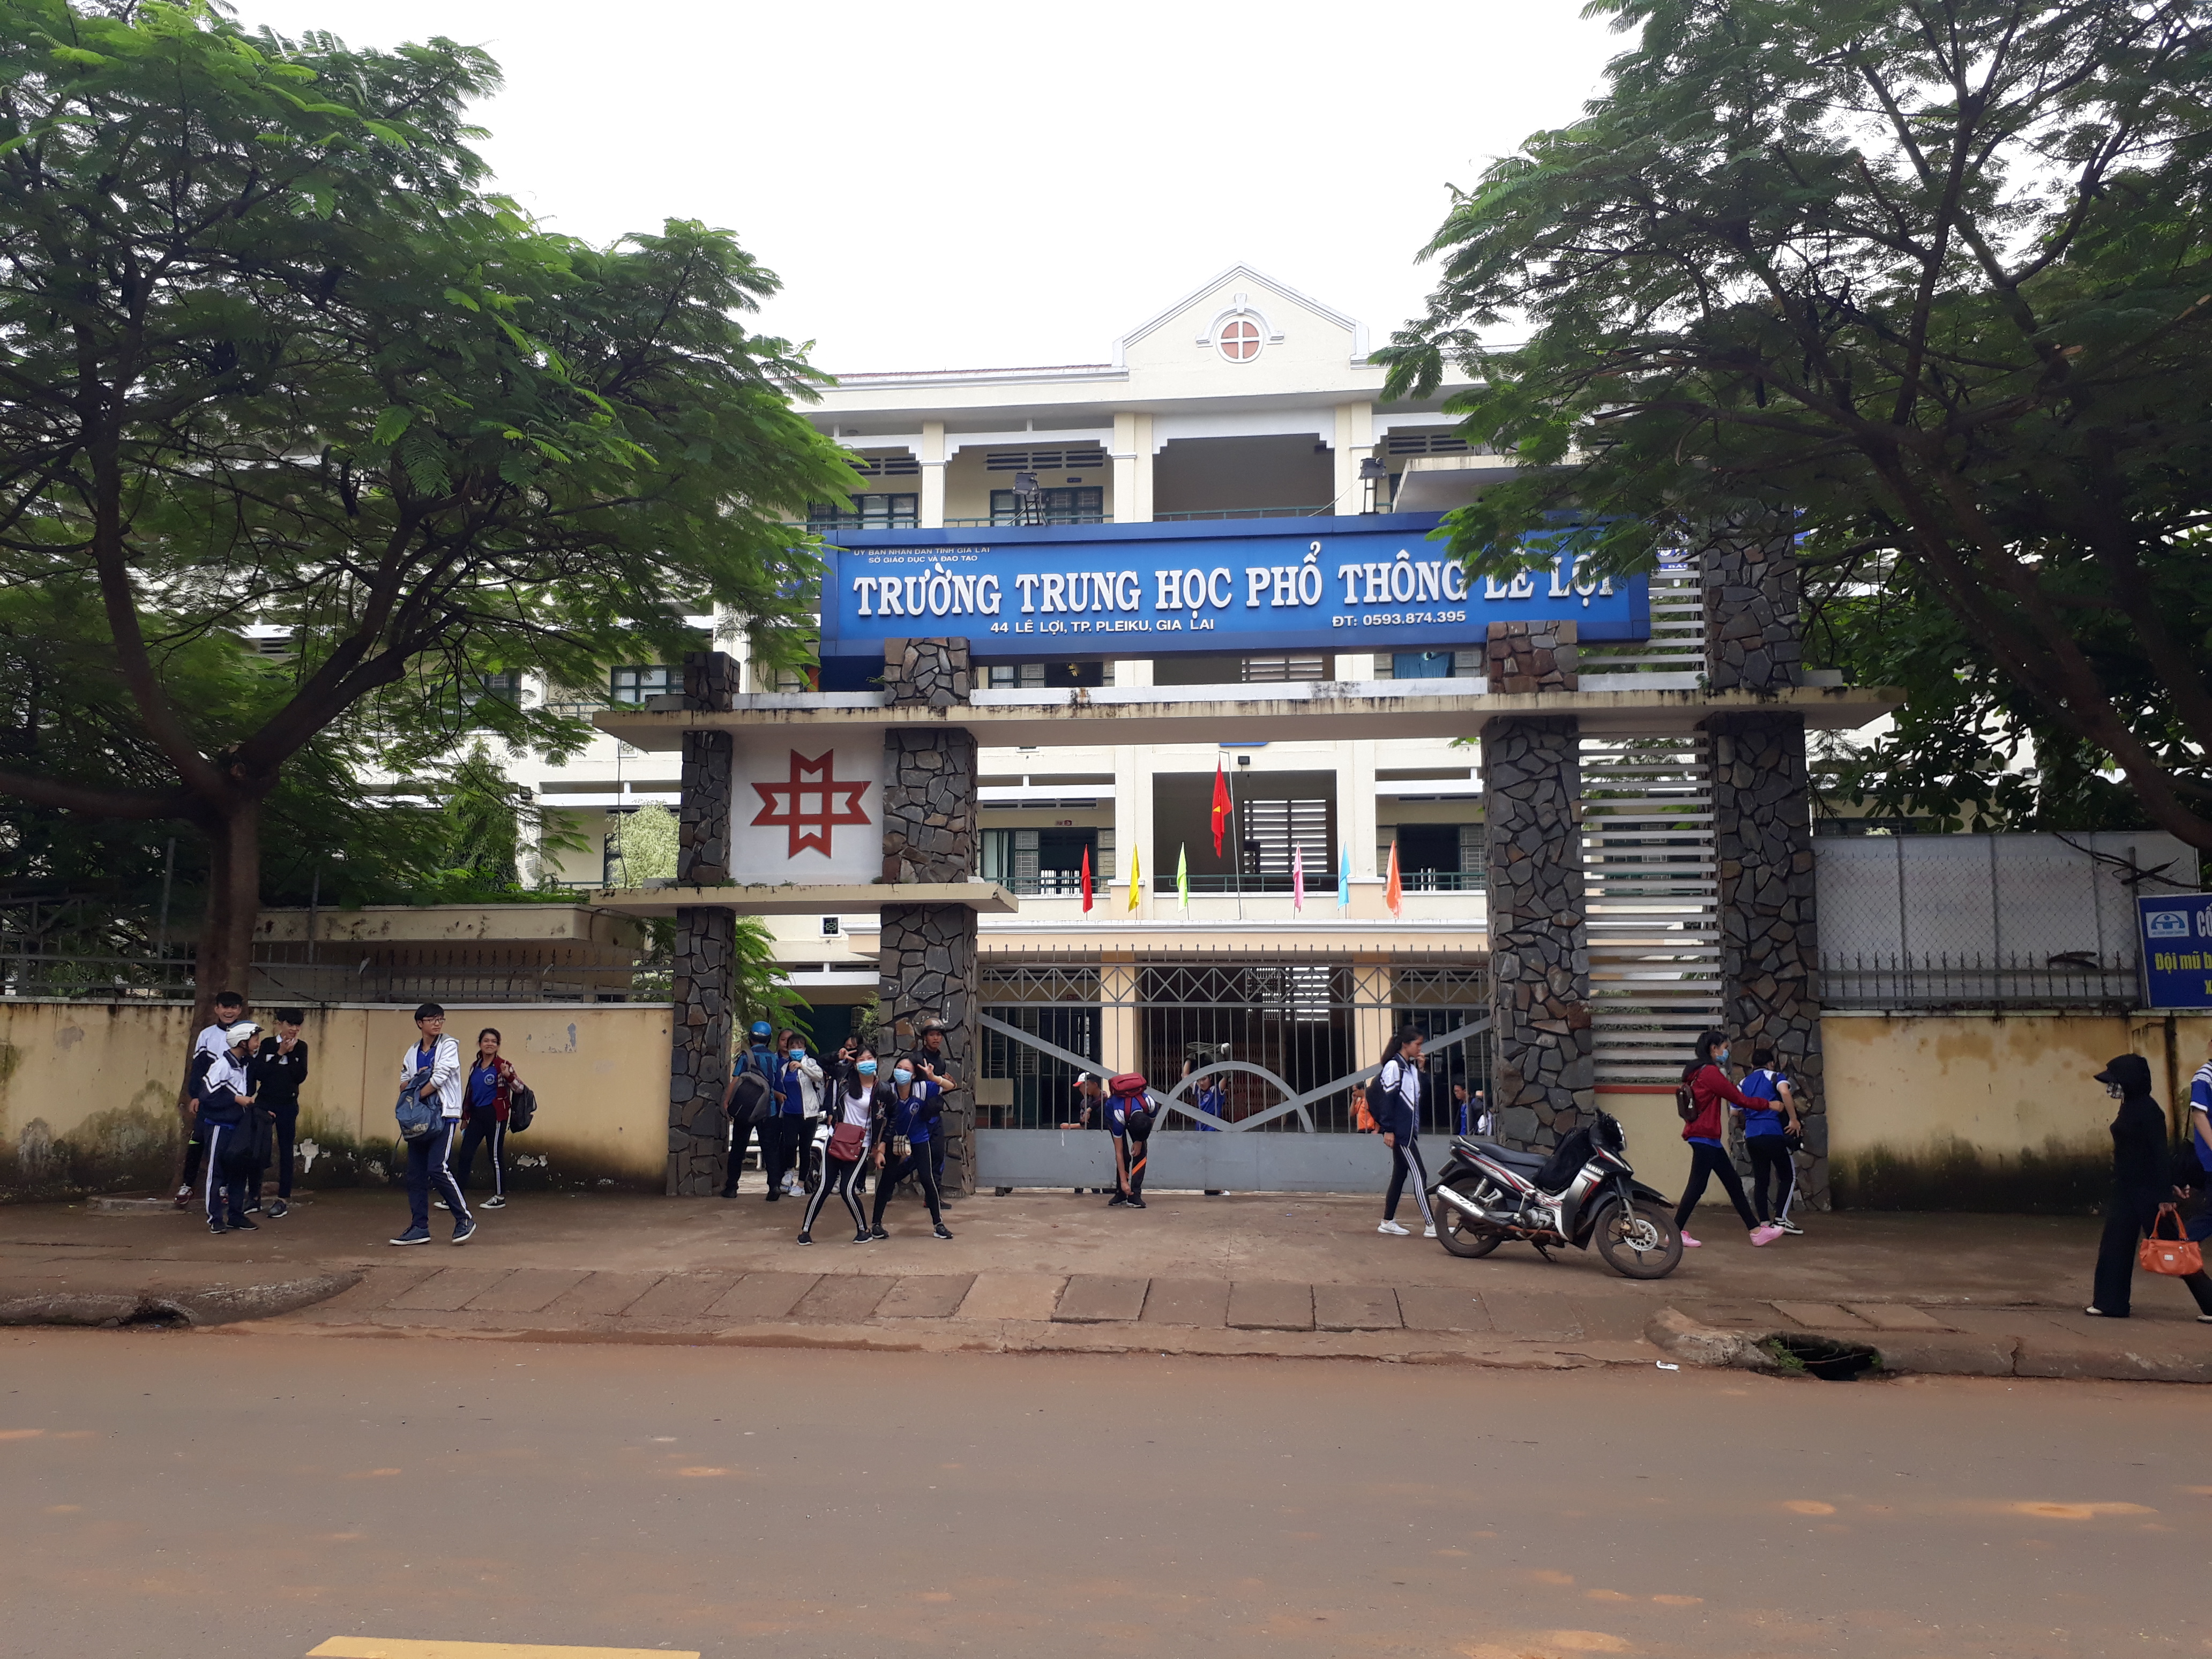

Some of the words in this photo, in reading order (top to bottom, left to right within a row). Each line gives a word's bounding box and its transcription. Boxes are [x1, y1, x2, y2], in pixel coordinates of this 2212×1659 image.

[853, 563, 1002, 617] TRƯỜNG
[1015, 571, 1141, 614] TRUNG
[1155, 567, 1232, 620] HỌC
[1245, 541, 1323, 608] PHỔ
[1337, 548, 1468, 604] THÔNG
[990, 622, 1009, 633] 44
[1015, 619, 1034, 633] LÊ
[1040, 620, 1067, 636] LỢI,
[1071, 621, 1092, 632] TP.
[1096, 620, 1152, 633] PLEIKU,
[1156, 619, 1183, 631] GIA
[1190, 619, 1214, 630] LAI
[1332, 615, 1358, 627] ĐT:
[1363, 610, 1467, 626] 0593.874.395
[2179, 951, 2201, 970] mũ
